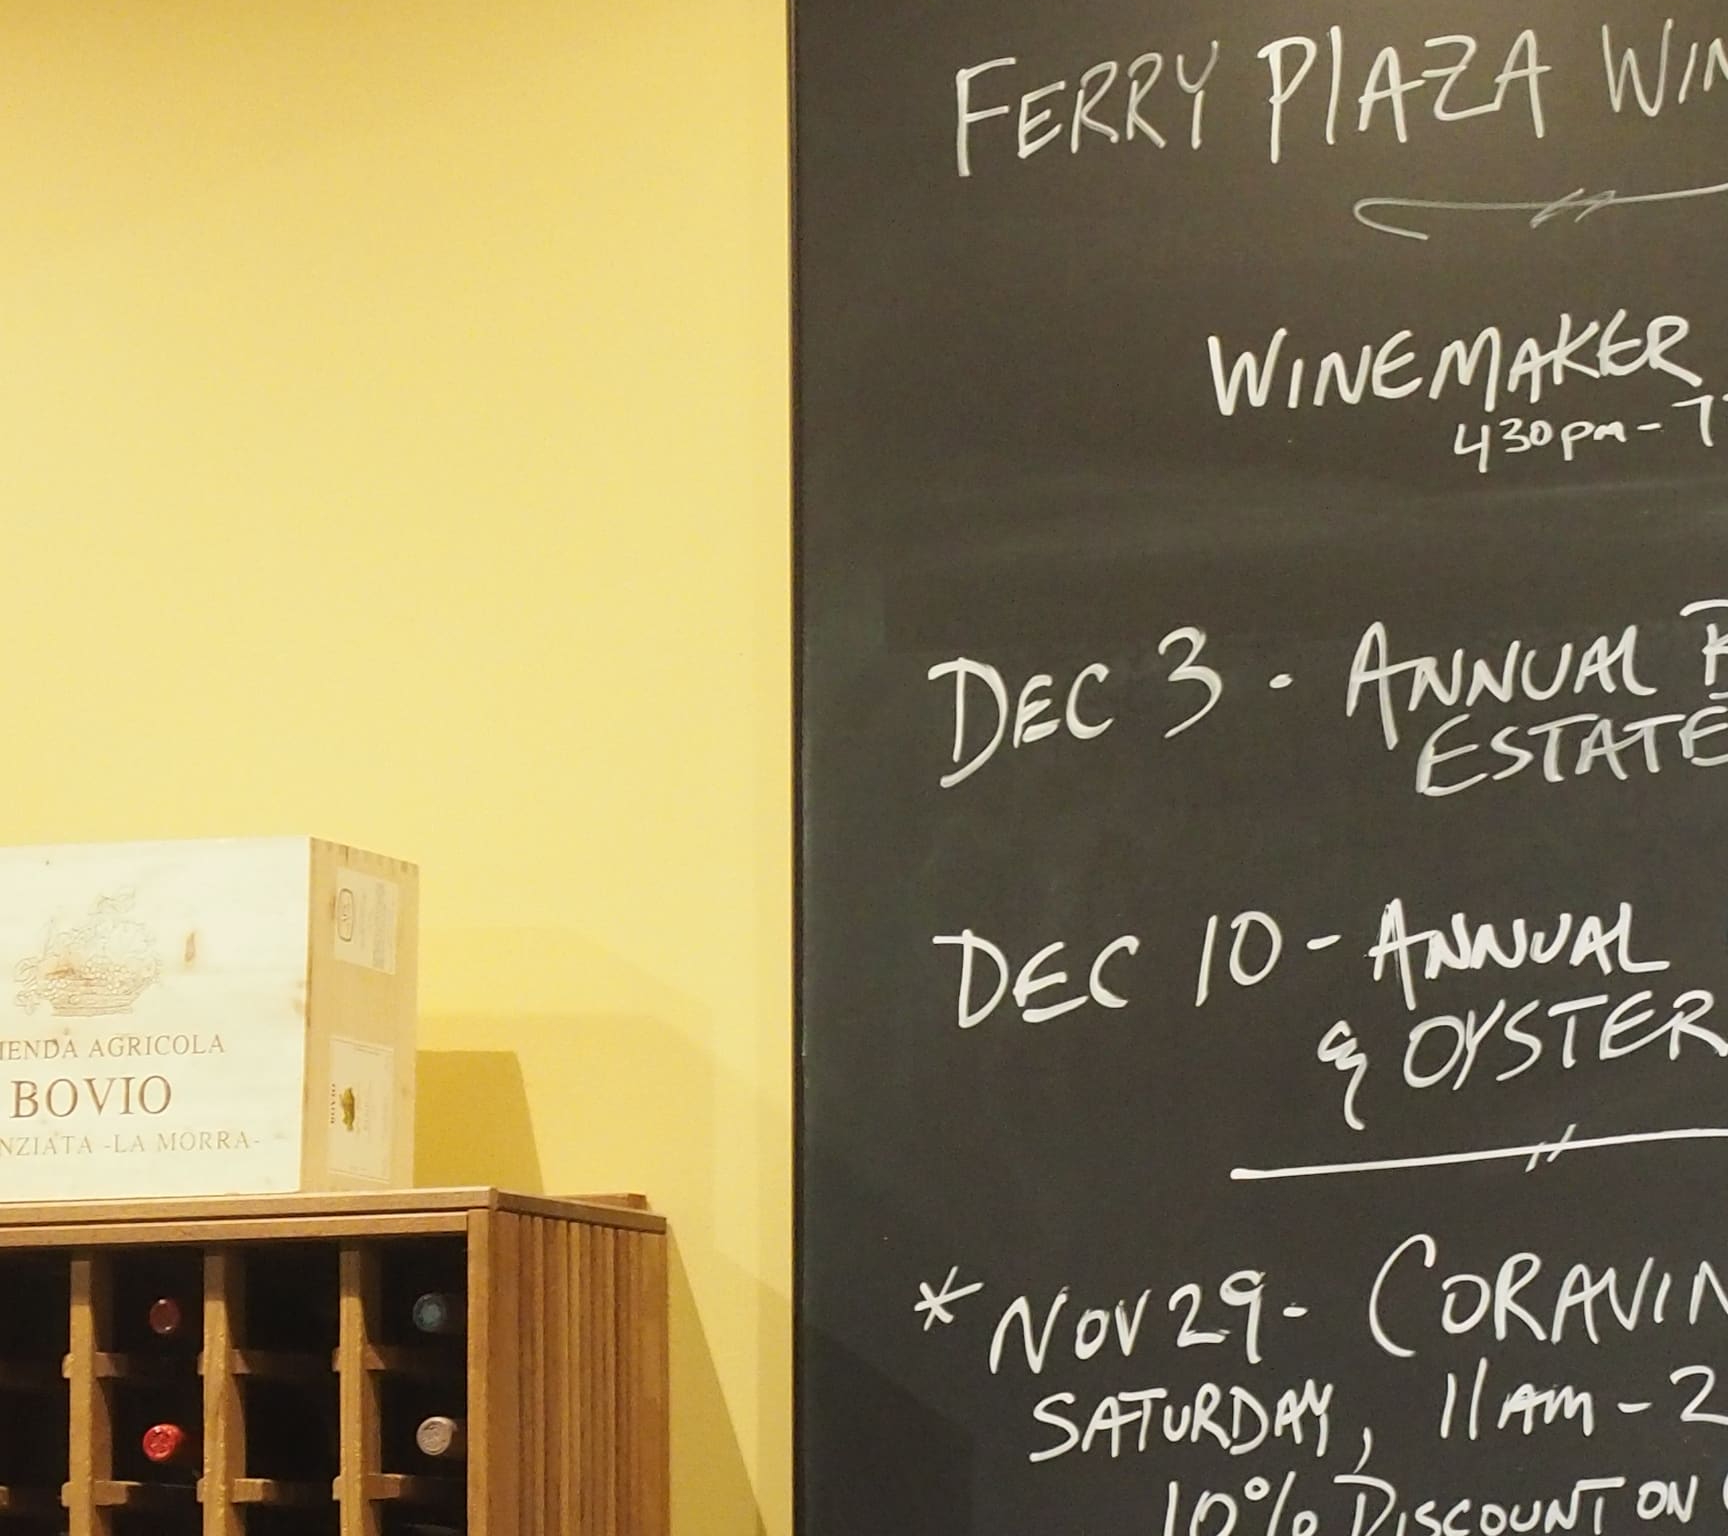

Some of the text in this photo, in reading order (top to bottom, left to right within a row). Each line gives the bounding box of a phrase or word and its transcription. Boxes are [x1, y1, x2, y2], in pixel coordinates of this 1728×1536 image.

[956, 40, 1219, 177] FERRY
[1208, 309, 1702, 416] WINEMAKER
[928, 657, 1114, 787] DEC
[1159, 626, 1222, 738] 3
[1345, 621, 1657, 750] ANNUAL
[933, 929, 1139, 1029] DEC
[1366, 898, 1670, 1010] ANNUAL
[88, 1034, 226, 1058] AGRICOLA
[9, 1075, 173, 1119] BOVIO
[989, 1287, 1152, 1375] NOV
[1637, 1473, 1699, 1526] ON
